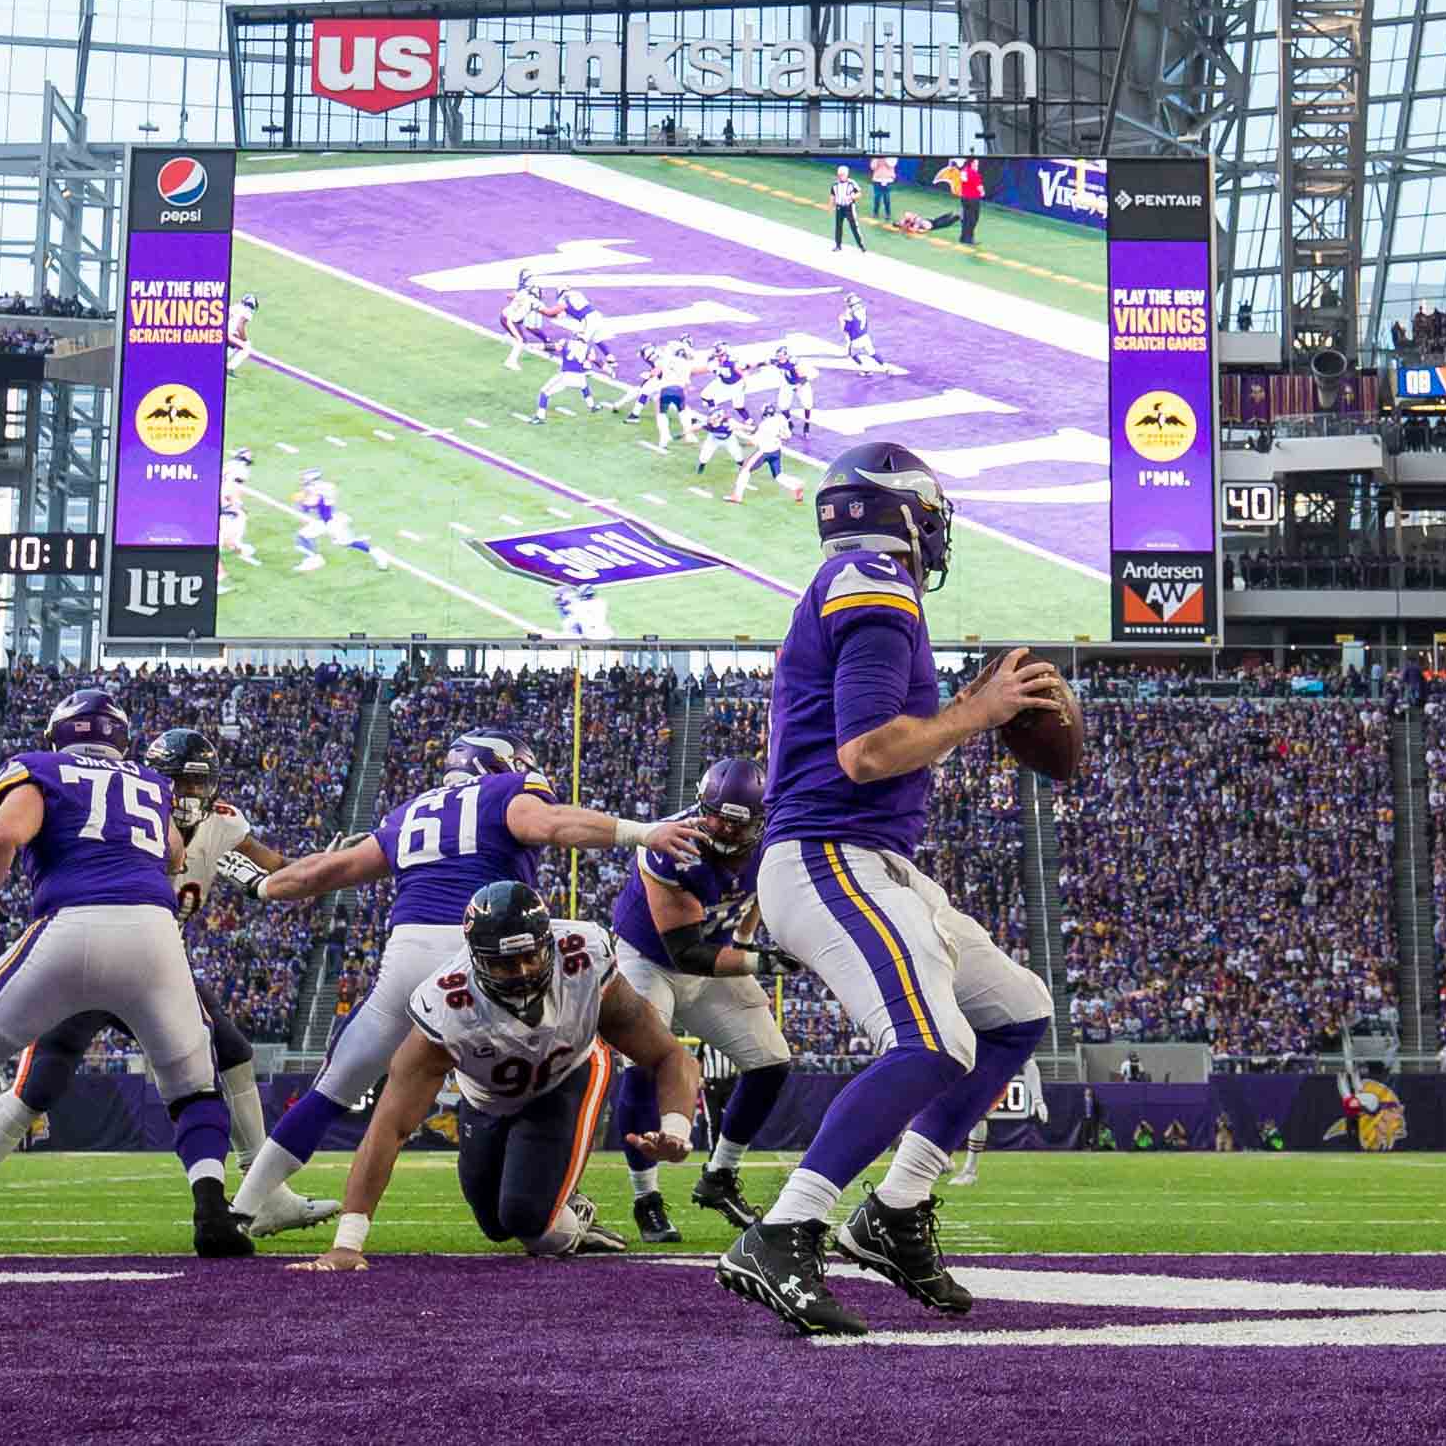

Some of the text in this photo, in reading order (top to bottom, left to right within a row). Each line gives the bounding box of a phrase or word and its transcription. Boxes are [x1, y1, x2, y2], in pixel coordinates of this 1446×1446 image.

[1135, 195, 1202, 206] PENTAIR
[160, 209, 202, 224] pepsi
[131, 281, 226, 298] PLAY THE NEW
[1114, 290, 1205, 305] PLAY THE NEW
[131, 299, 224, 326] VIKINGS
[1114, 308, 1206, 334] VIKINGS
[129, 328, 223, 344] SCRATCH GAMES
[1114, 336, 1206, 350] SCRATCH GAMES
[1228, 487, 1272, 520] 40
[9, 536, 97, 571] 10:11
[1122, 561, 1203, 579] Andersen
[125, 568, 203, 617] Lite
[59, 762, 166, 859] 75
[396, 783, 482, 869] 61
